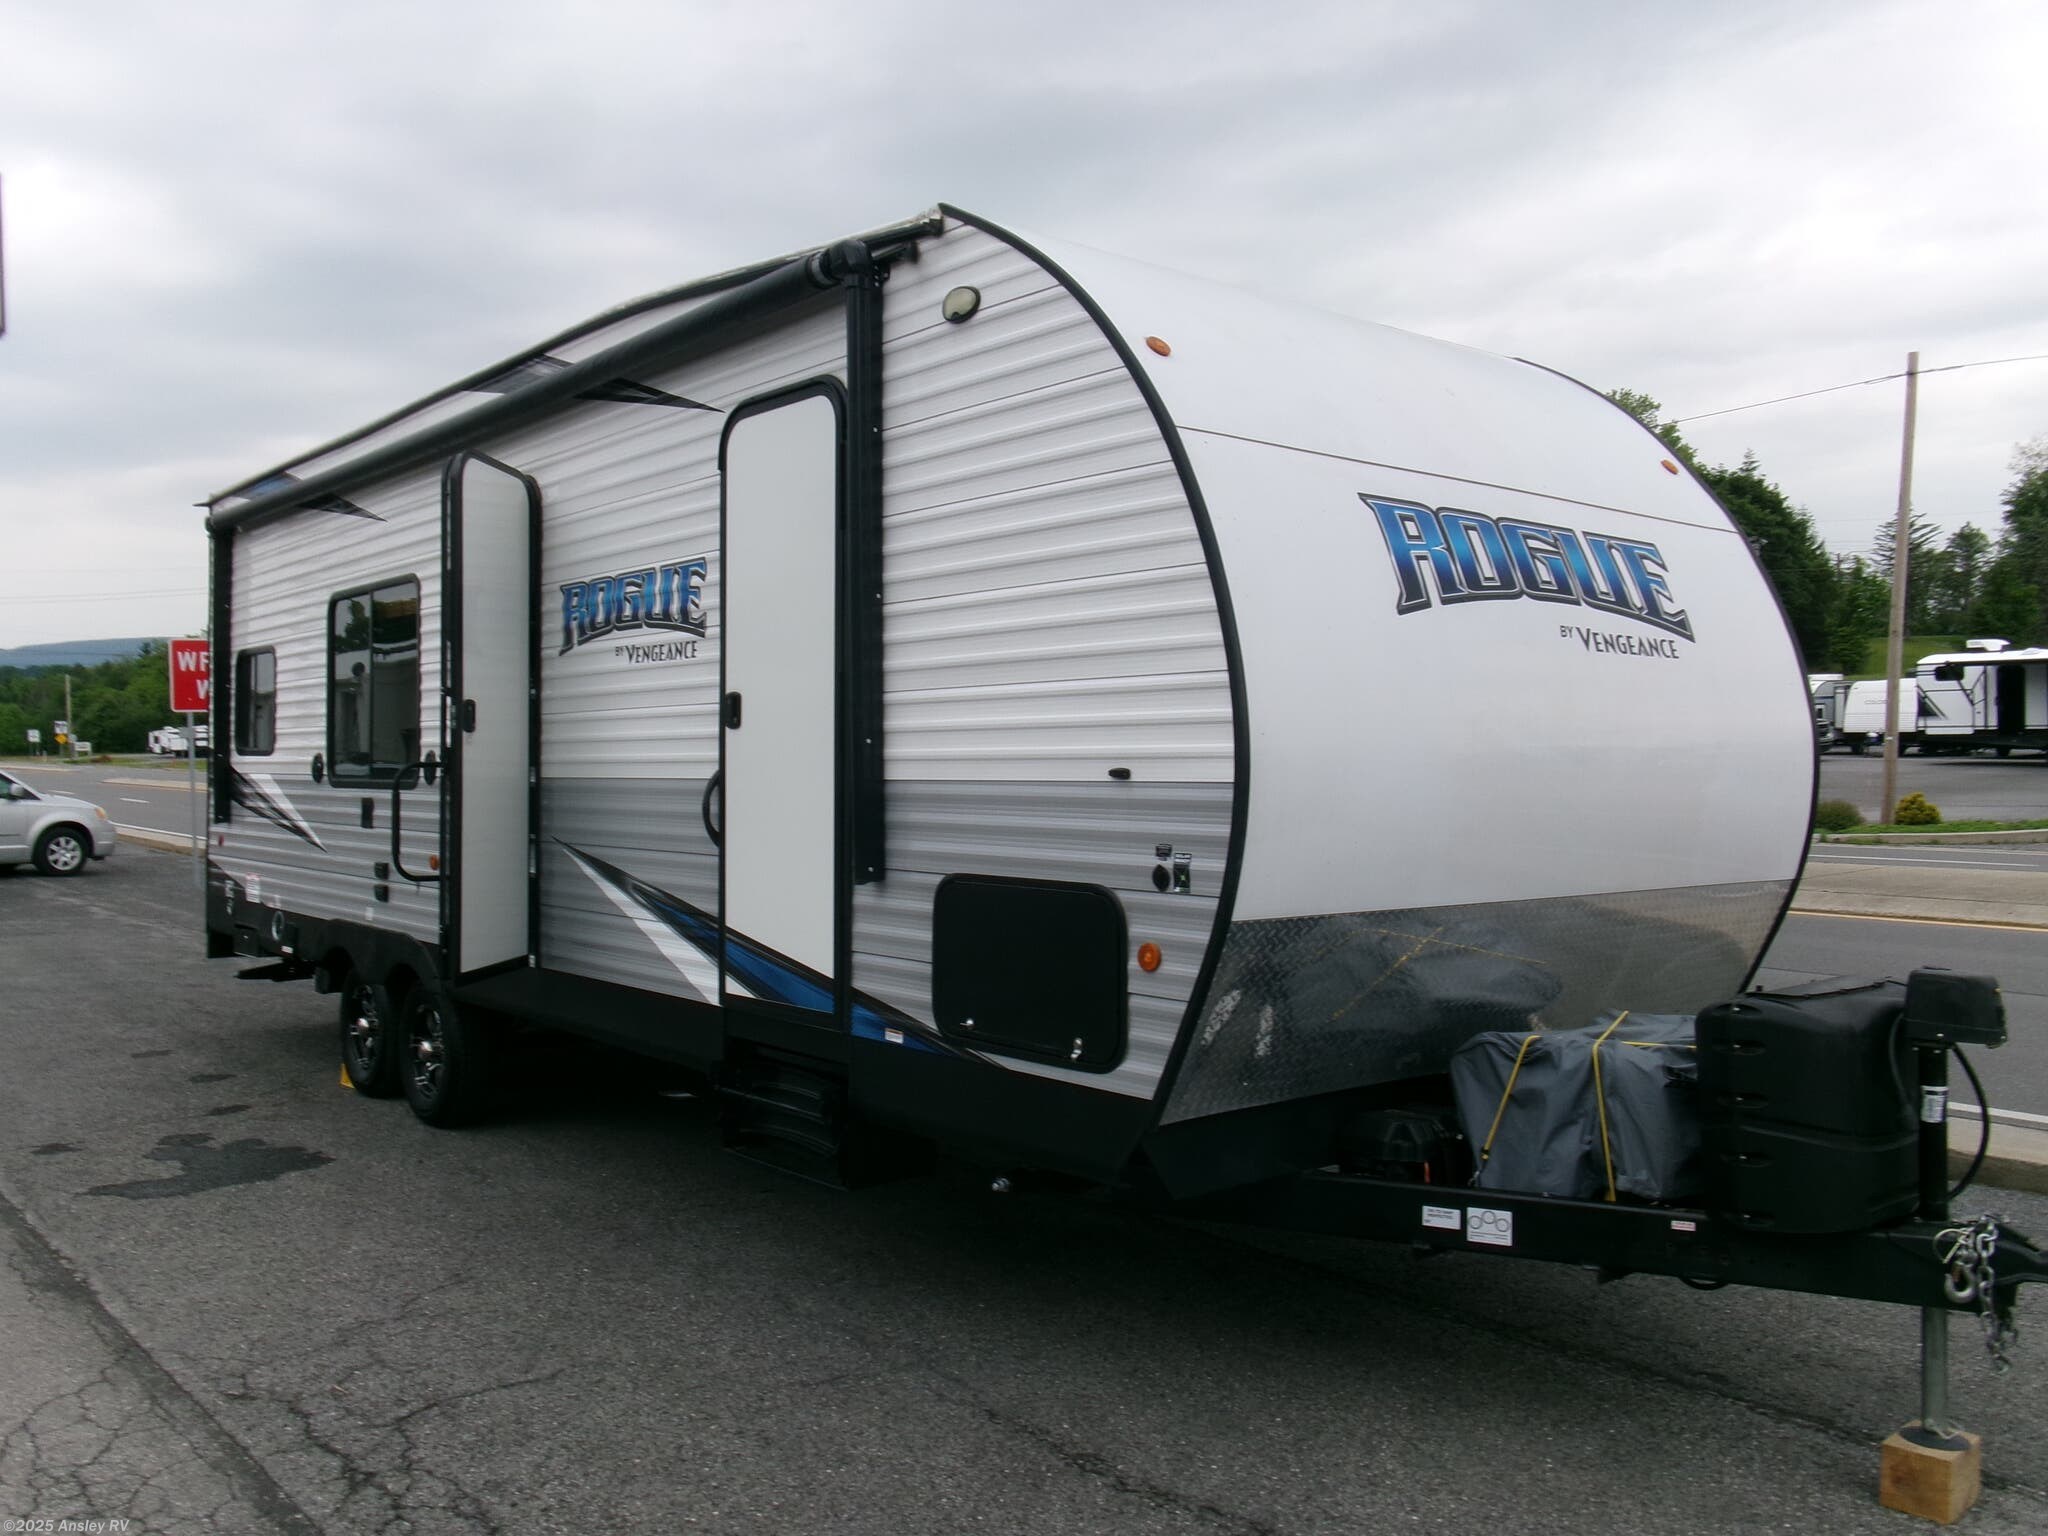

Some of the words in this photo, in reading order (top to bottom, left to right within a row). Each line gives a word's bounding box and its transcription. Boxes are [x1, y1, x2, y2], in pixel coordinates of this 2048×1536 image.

[558, 556, 708, 657] ROGUE
[1357, 491, 1696, 643] ROGUE
[1559, 625, 1575, 639] BY
